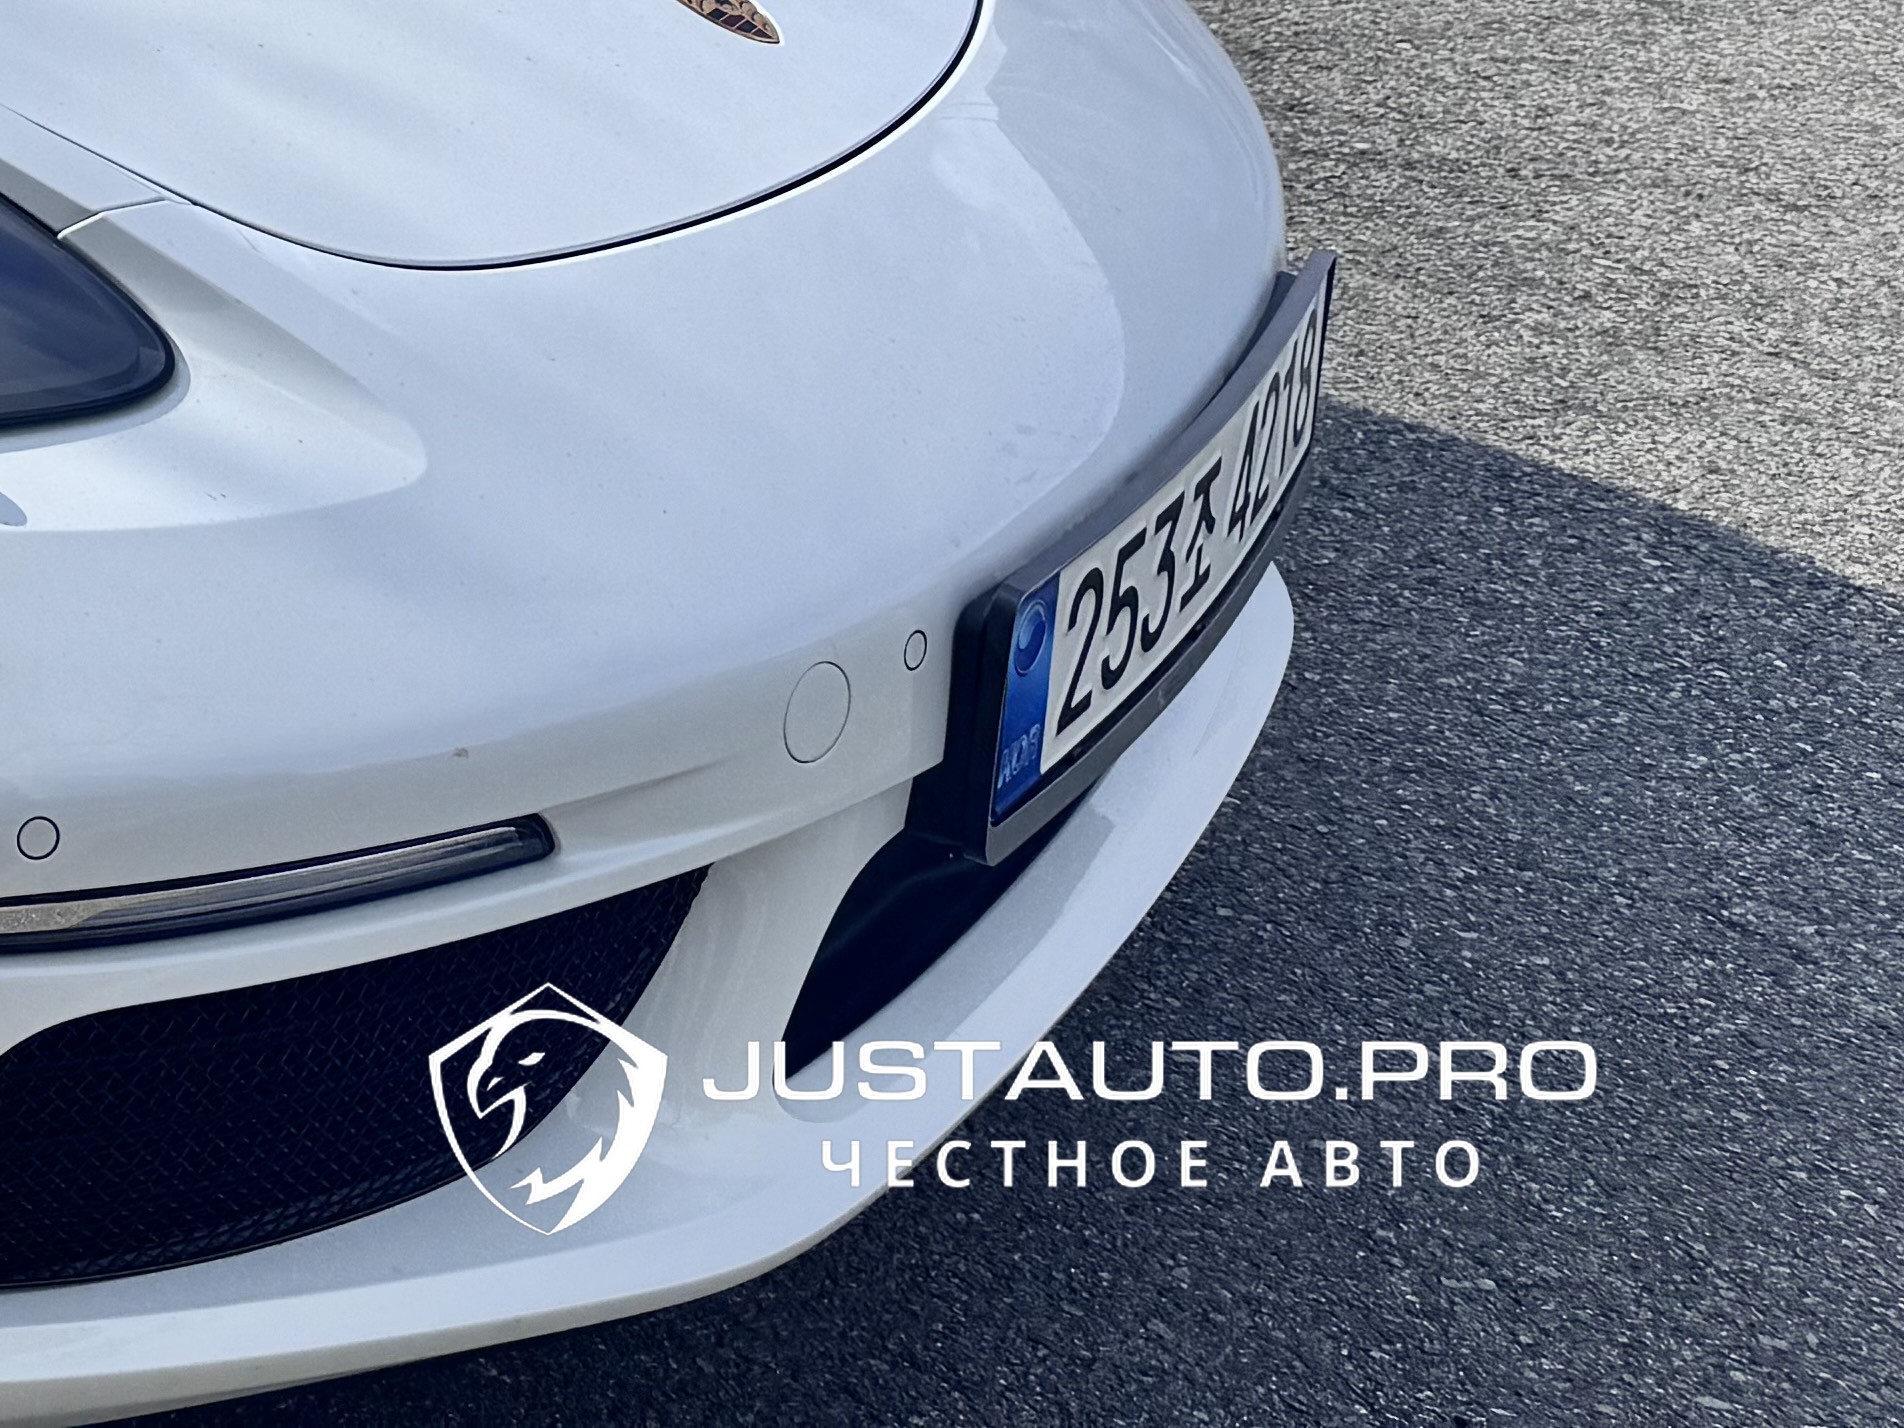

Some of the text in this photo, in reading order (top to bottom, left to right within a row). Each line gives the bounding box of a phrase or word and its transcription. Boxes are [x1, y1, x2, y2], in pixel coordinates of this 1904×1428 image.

[1056, 308, 1318, 737] 253조 4218
[996, 722, 1041, 790] KOR
